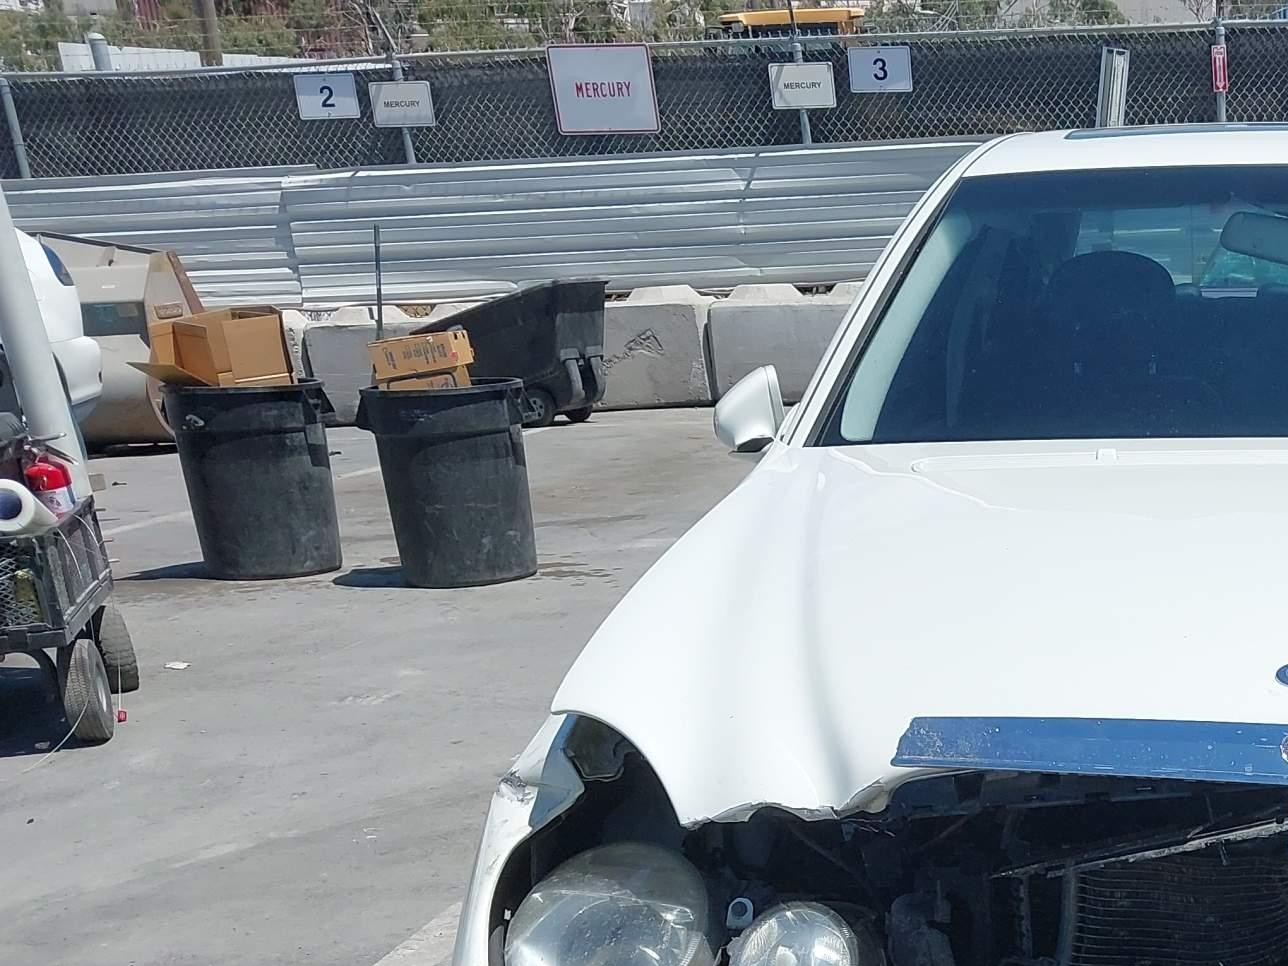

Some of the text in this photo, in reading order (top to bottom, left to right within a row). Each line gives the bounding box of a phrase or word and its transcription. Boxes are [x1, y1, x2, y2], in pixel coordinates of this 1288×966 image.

[872, 57, 888, 81] 3
[574, 81, 633, 99] MERCURY
[783, 81, 822, 90] MERCURY
[318, 84, 337, 108] 2
[383, 100, 420, 110] MERCURY
